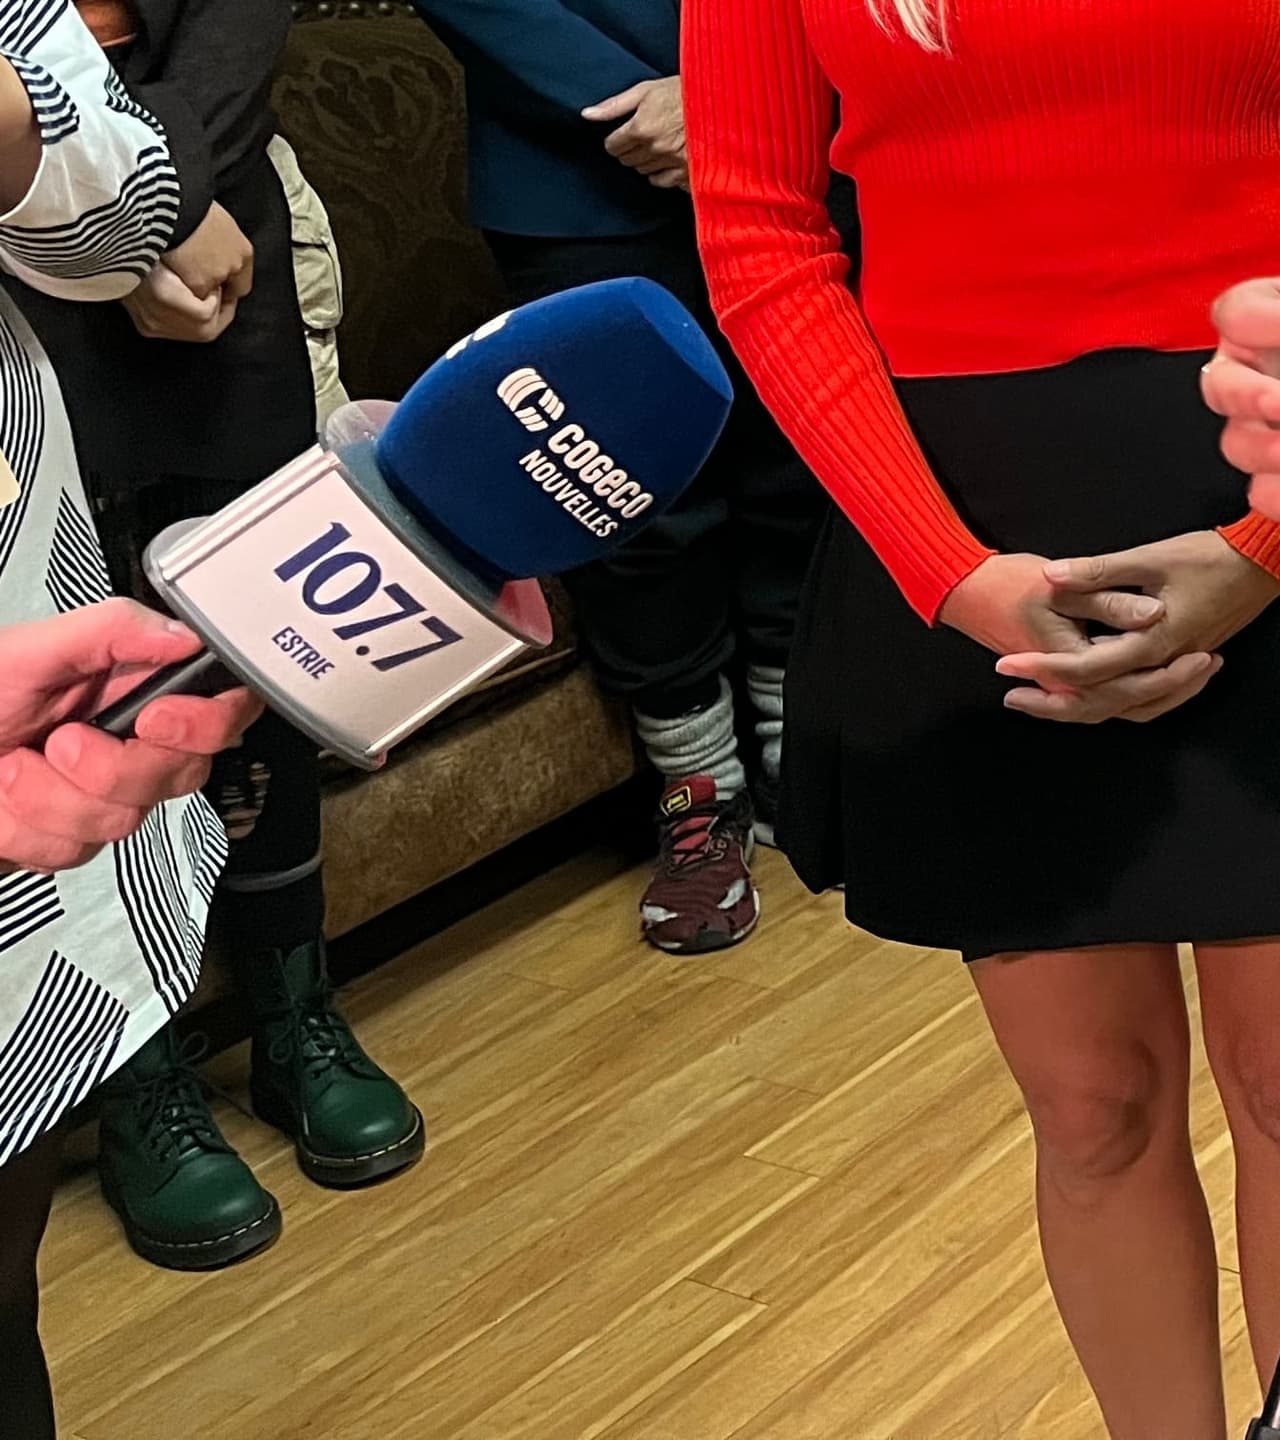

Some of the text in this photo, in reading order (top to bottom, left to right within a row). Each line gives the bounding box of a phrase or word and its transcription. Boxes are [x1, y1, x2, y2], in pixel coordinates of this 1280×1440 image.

[518, 448, 619, 537] NOUVELLES
[273, 521, 465, 672] 107.7
[271, 626, 336, 680] ESTRIE
